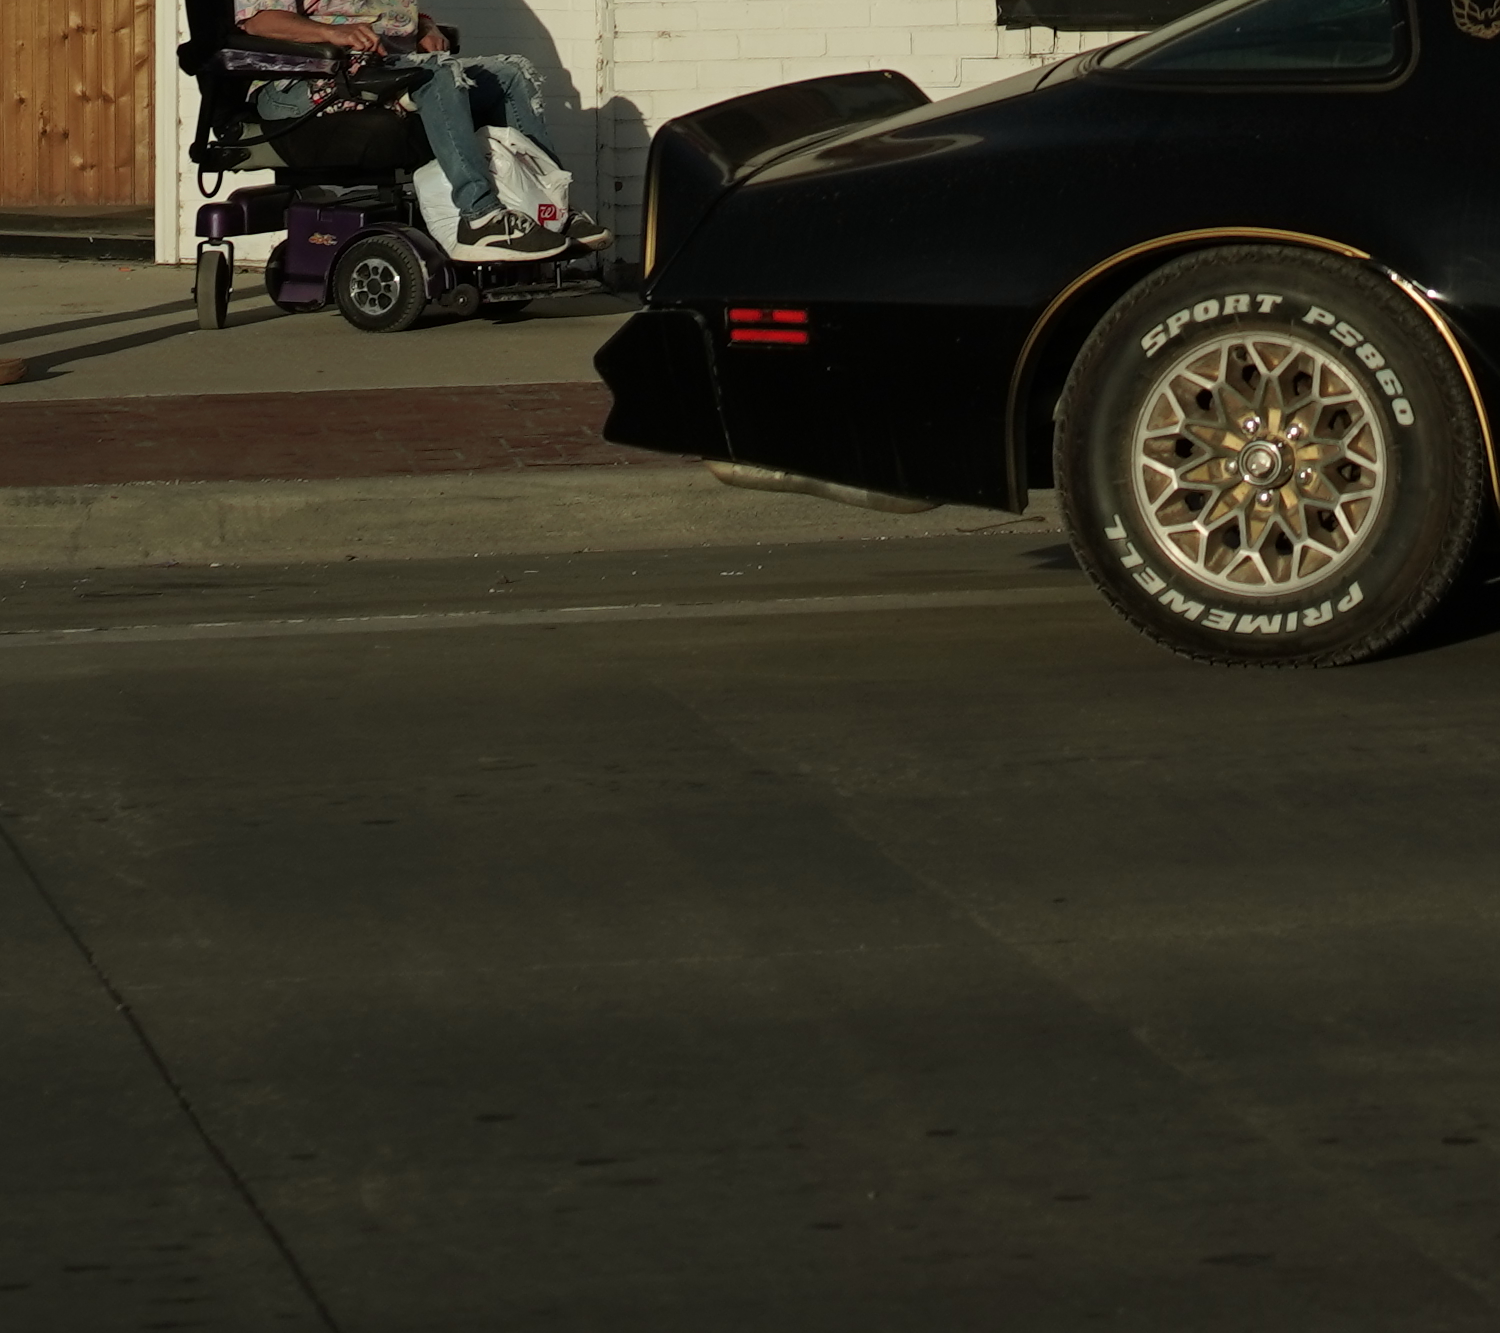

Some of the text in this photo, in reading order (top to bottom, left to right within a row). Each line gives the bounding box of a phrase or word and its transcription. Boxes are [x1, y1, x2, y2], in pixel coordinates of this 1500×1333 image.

[1139, 293, 1417, 427] SPORT PS860
[1103, 513, 1365, 635] PRIMEWELL
